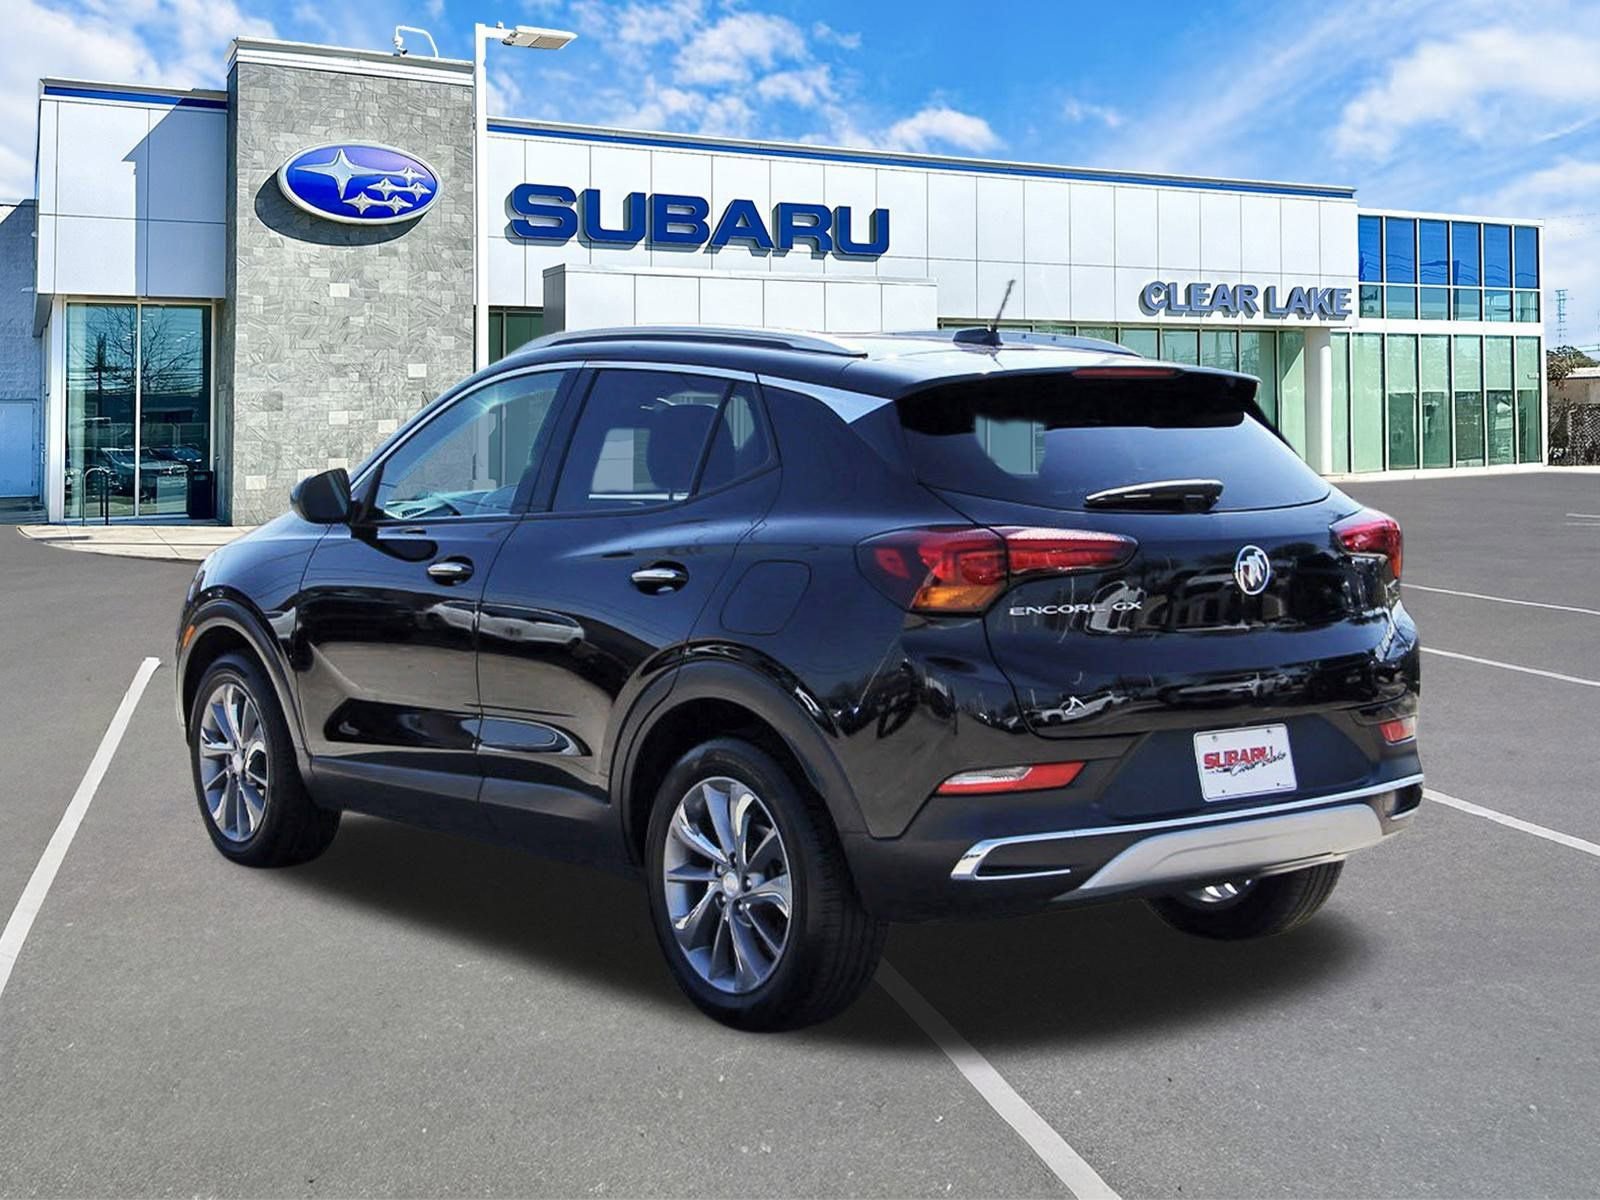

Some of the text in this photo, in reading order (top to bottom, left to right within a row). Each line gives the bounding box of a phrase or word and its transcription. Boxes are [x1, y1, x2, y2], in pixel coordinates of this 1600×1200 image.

[506, 183, 890, 261] SUBARU
[1140, 280, 1353, 320] CLEAR LAKE
[1009, 601, 1142, 616] ENCORE GX
[1203, 746, 1273, 769] SUBARU
